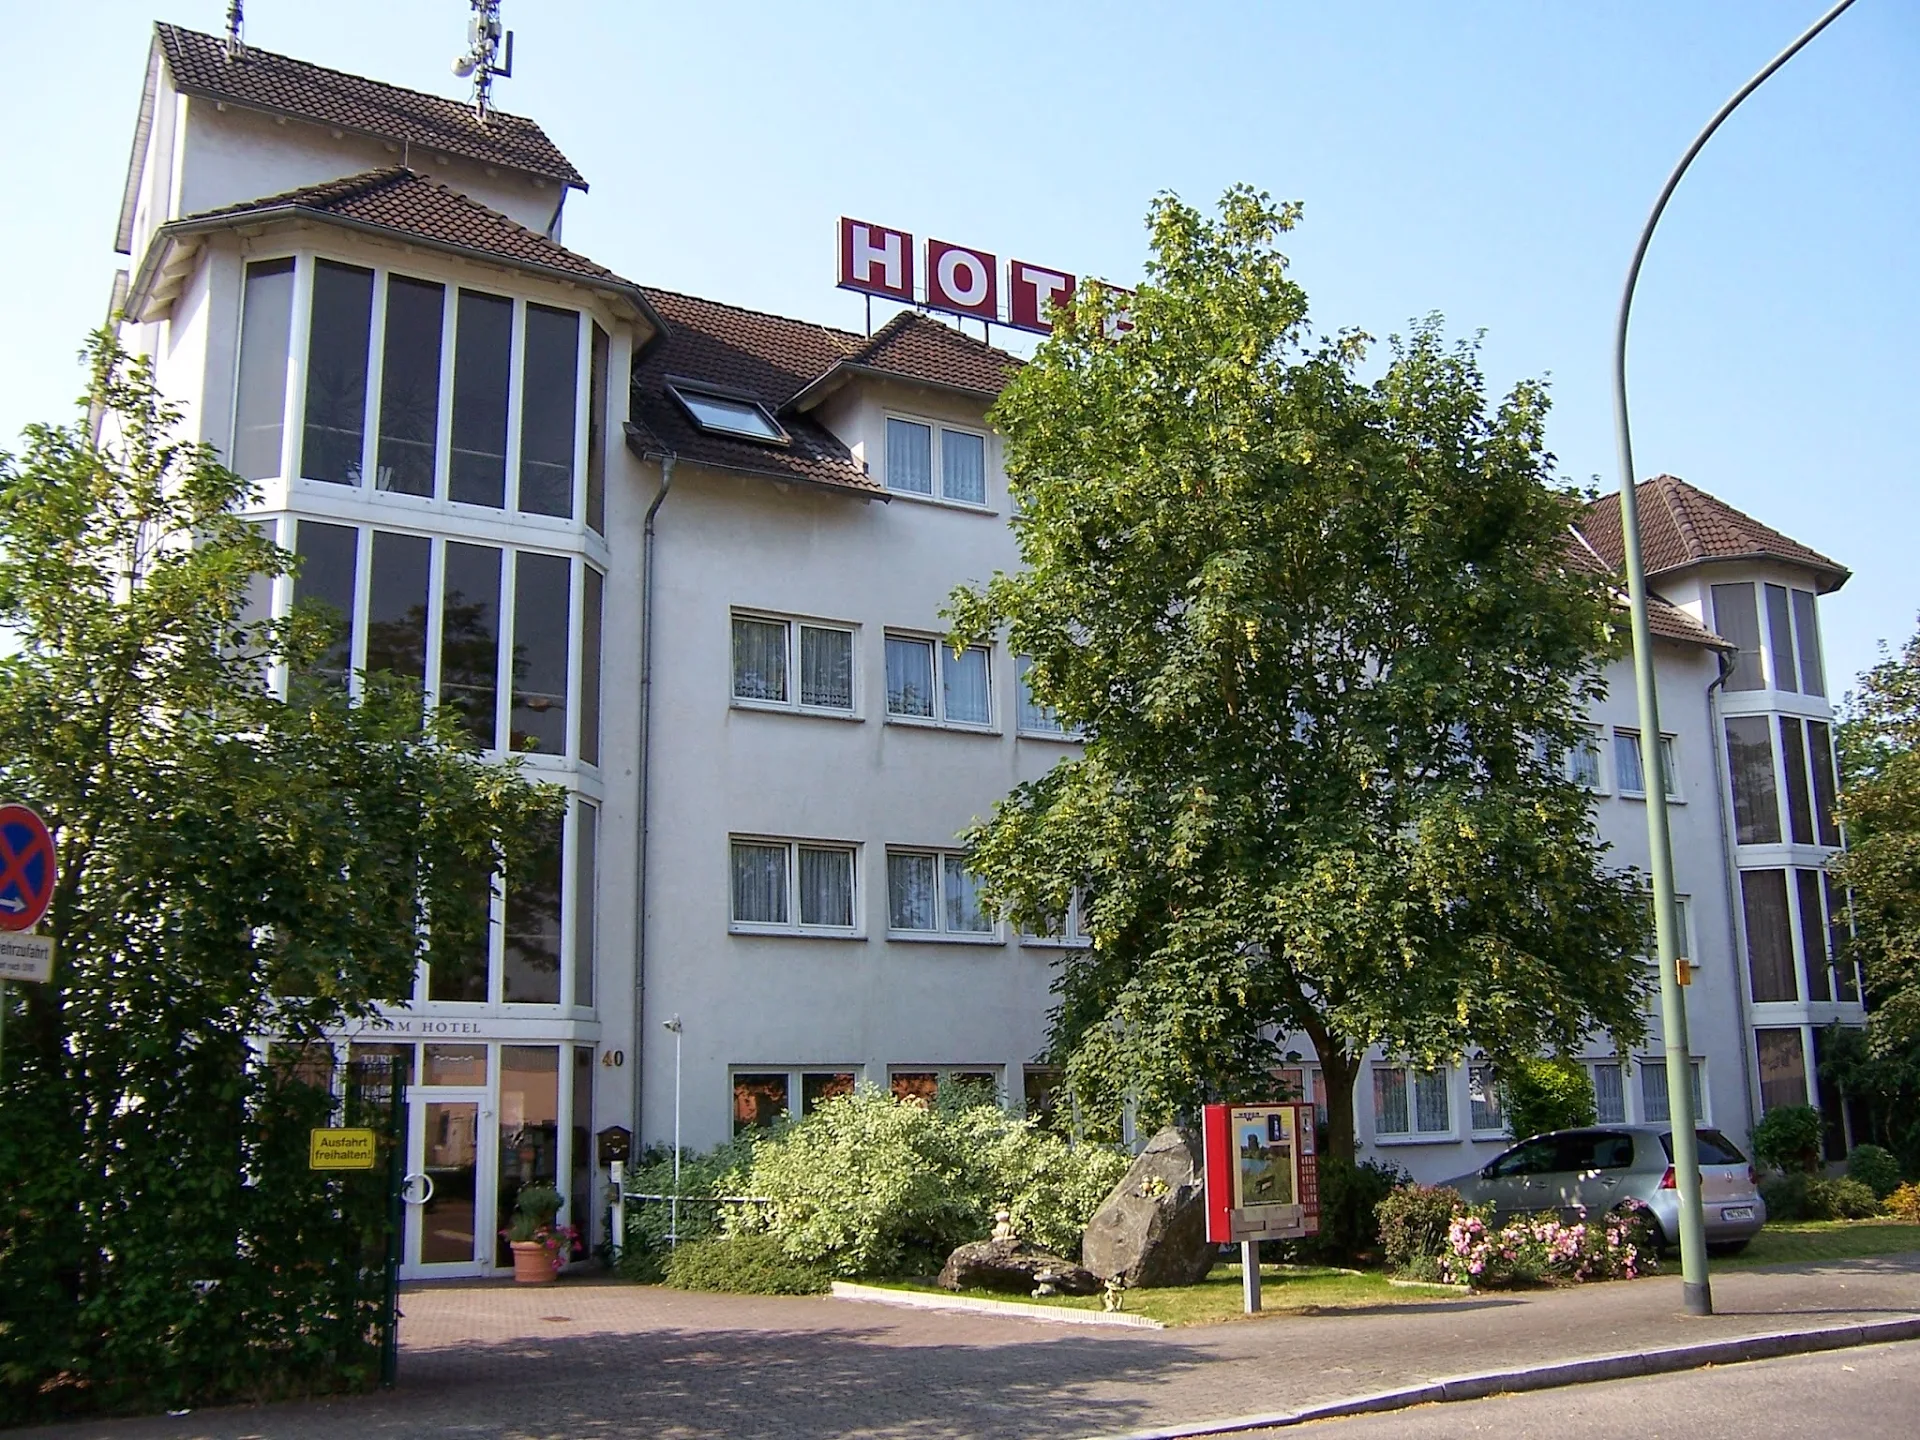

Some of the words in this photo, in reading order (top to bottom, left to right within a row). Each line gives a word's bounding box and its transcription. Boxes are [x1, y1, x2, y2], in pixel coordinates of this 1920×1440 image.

[0, 941, 49, 960] ehrzufahrt
[422, 1022, 482, 1034] HOTEL
[602, 1049, 624, 1068] 40
[320, 1137, 368, 1148] Ausfahrt
[315, 1150, 371, 1160] freihalten!
